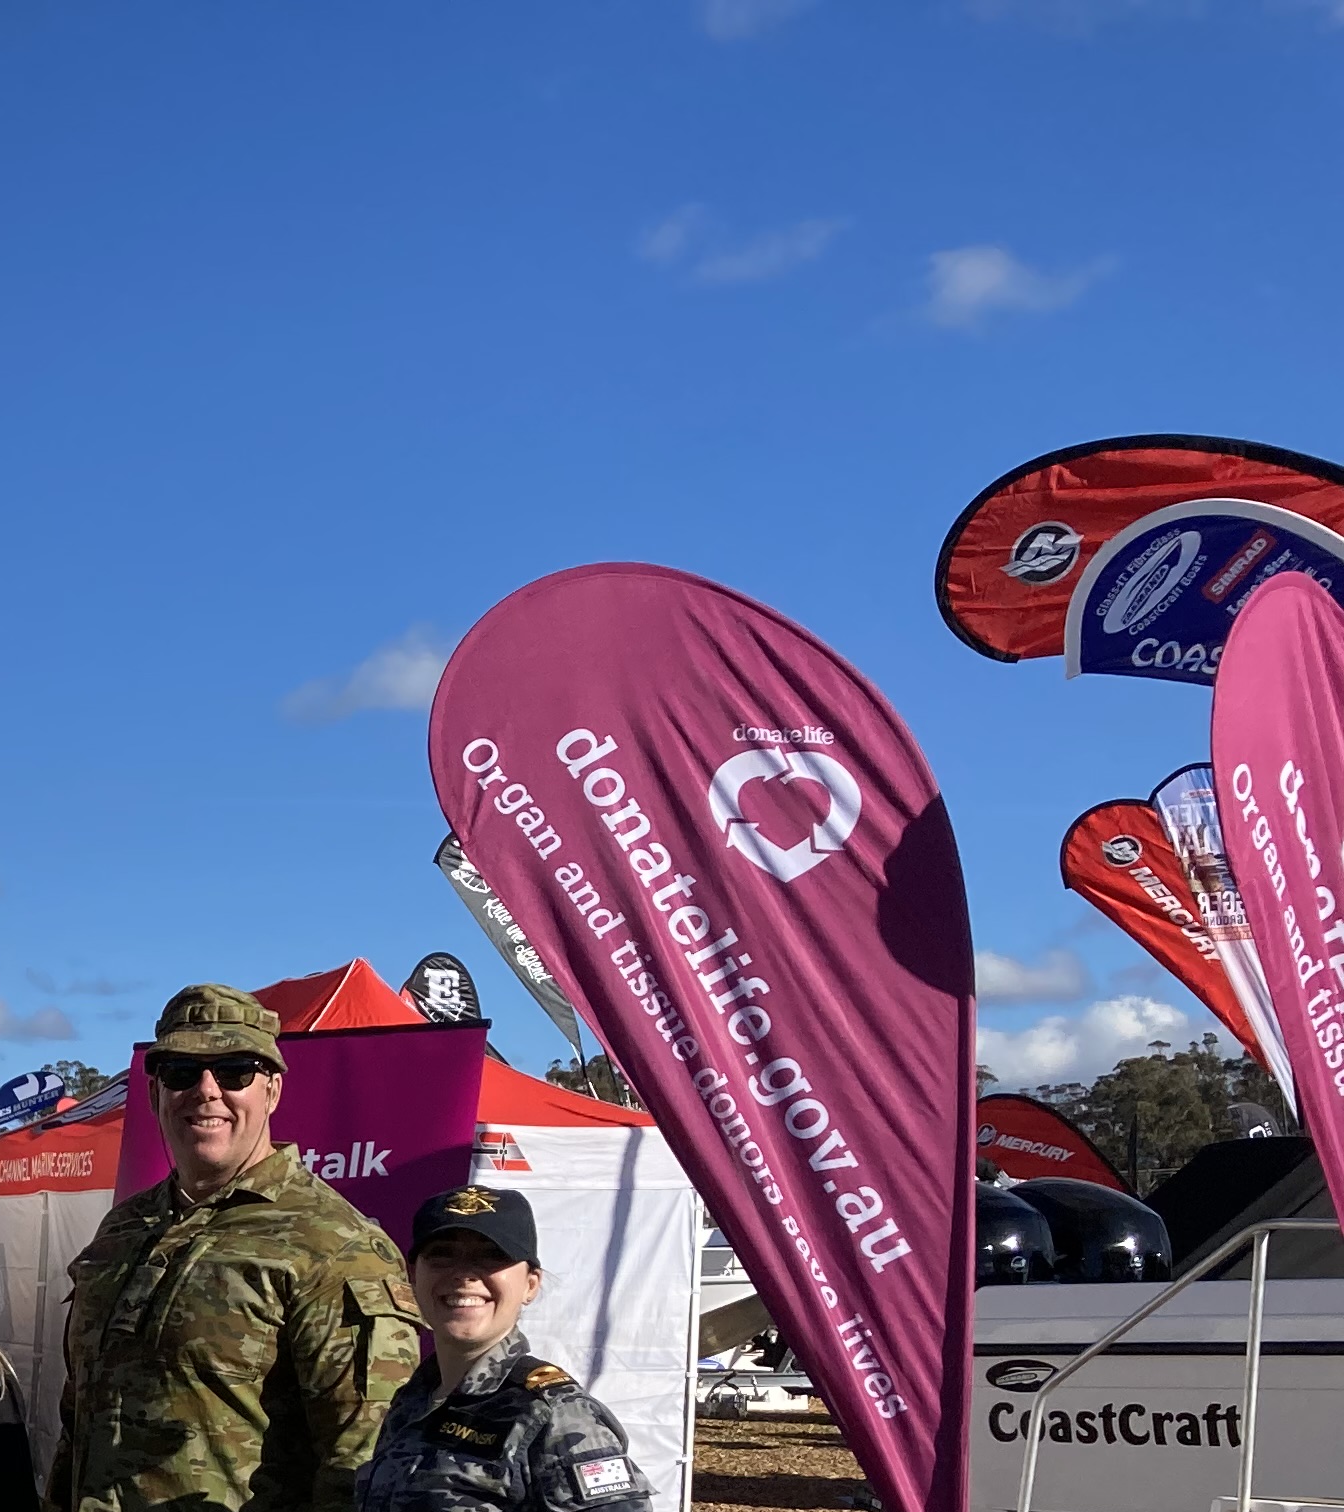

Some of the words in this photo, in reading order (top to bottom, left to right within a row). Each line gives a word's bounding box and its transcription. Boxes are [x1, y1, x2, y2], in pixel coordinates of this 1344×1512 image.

[1211, 537, 1268, 597] SIMRAD
[732, 722, 834, 746] donatelife
[1232, 763, 1287, 902] Organ
[1284, 904, 1325, 989] and
[1129, 866, 1220, 960] MERCURY
[556, 727, 912, 1274] donatelife.gov.au
[462, 737, 564, 861] Organ
[554, 861, 625, 941] and
[610, 938, 700, 1062] tissue
[693, 1067, 784, 1206] donors
[781, 1215, 838, 1309] save
[837, 1312, 908, 1420] lives
[12, 1089, 59, 1112] HUNTER
[302, 1140, 392, 1180] talk
[994, 1133, 1076, 1161] MERCURY
[31, 1152, 56, 1179] MARINE
[55, 1150, 94, 1178] SERVICES
[439, 1421, 497, 1446] SOWINSKI
[589, 1481, 632, 1496] AUSTRALIA
